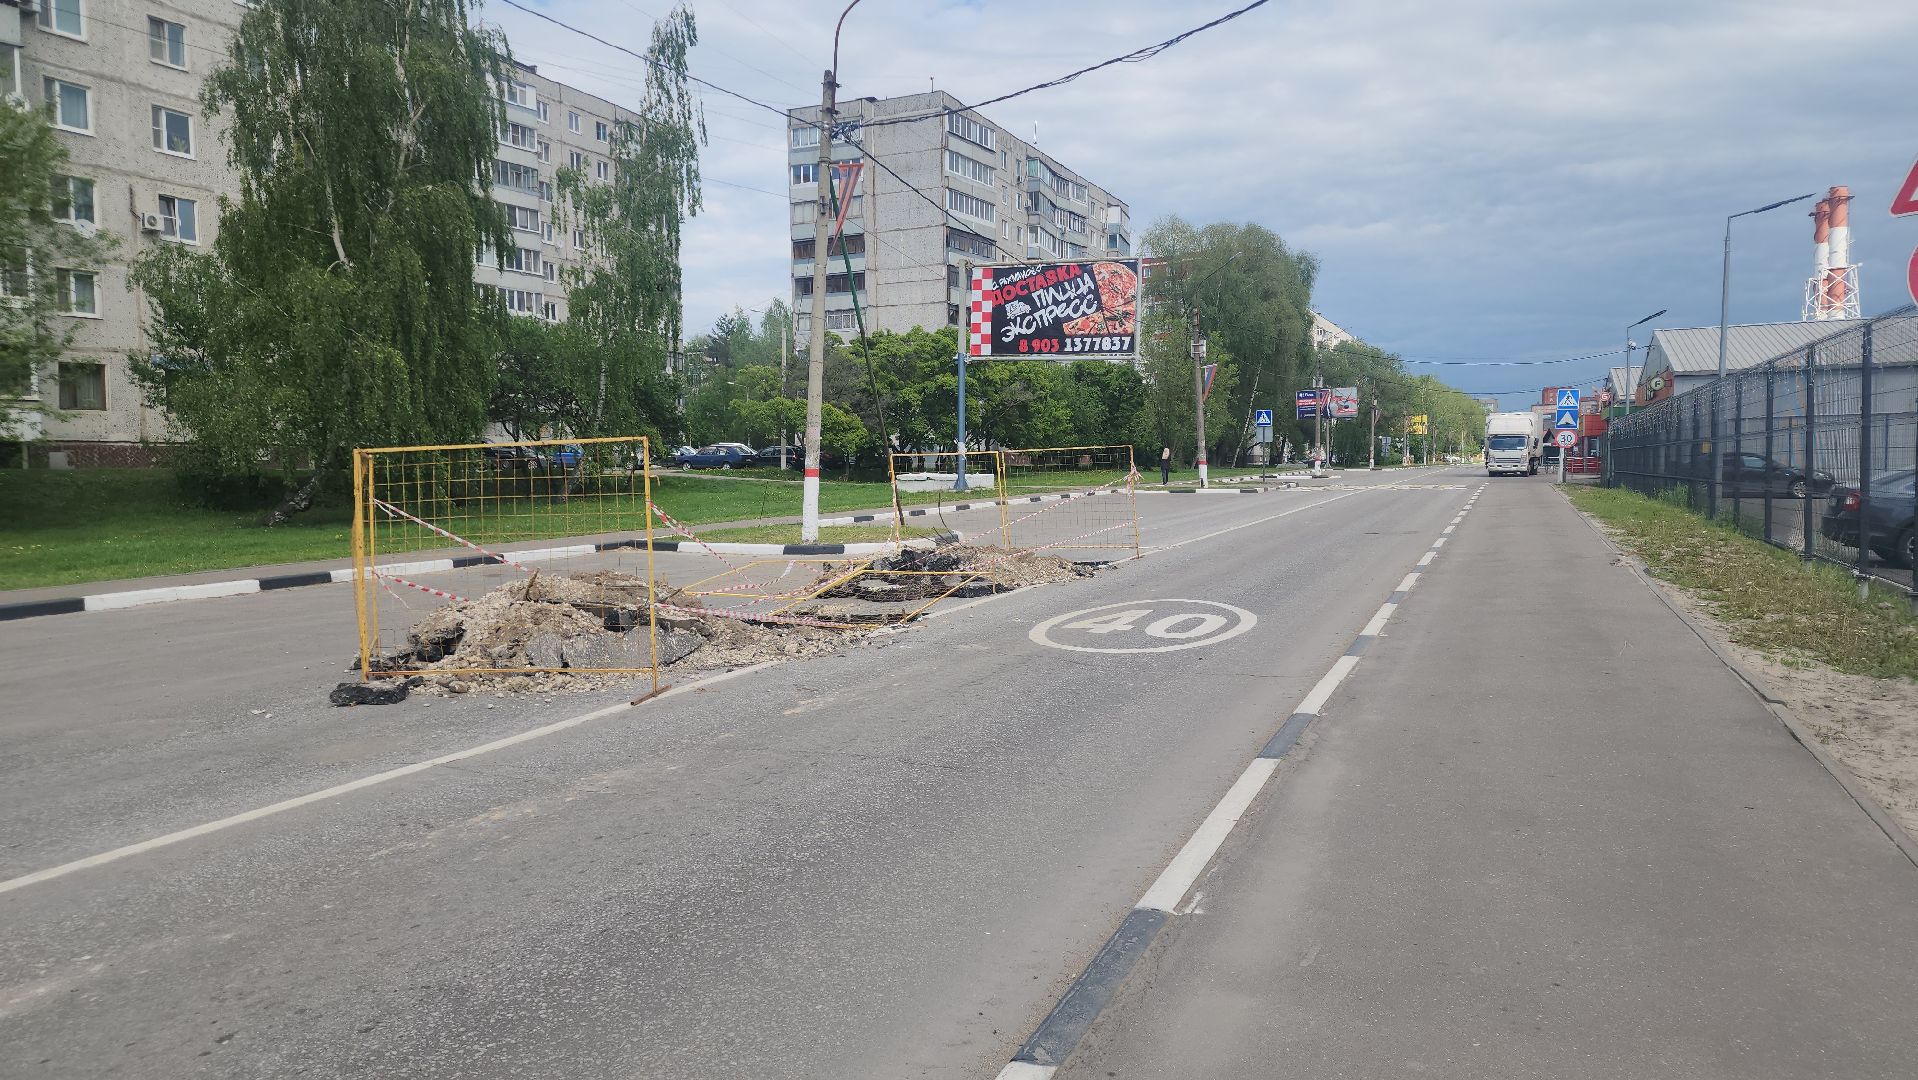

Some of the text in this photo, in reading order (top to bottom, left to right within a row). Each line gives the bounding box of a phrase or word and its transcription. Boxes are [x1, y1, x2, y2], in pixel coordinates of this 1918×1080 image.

[992, 264, 1082, 308] ДОСТАВКА
[1031, 272, 1095, 309] ПИЦЦА
[1018, 338, 1028, 353] 8
[1560, 434, 1573, 443] 30
[1060, 609, 1228, 639] 40
